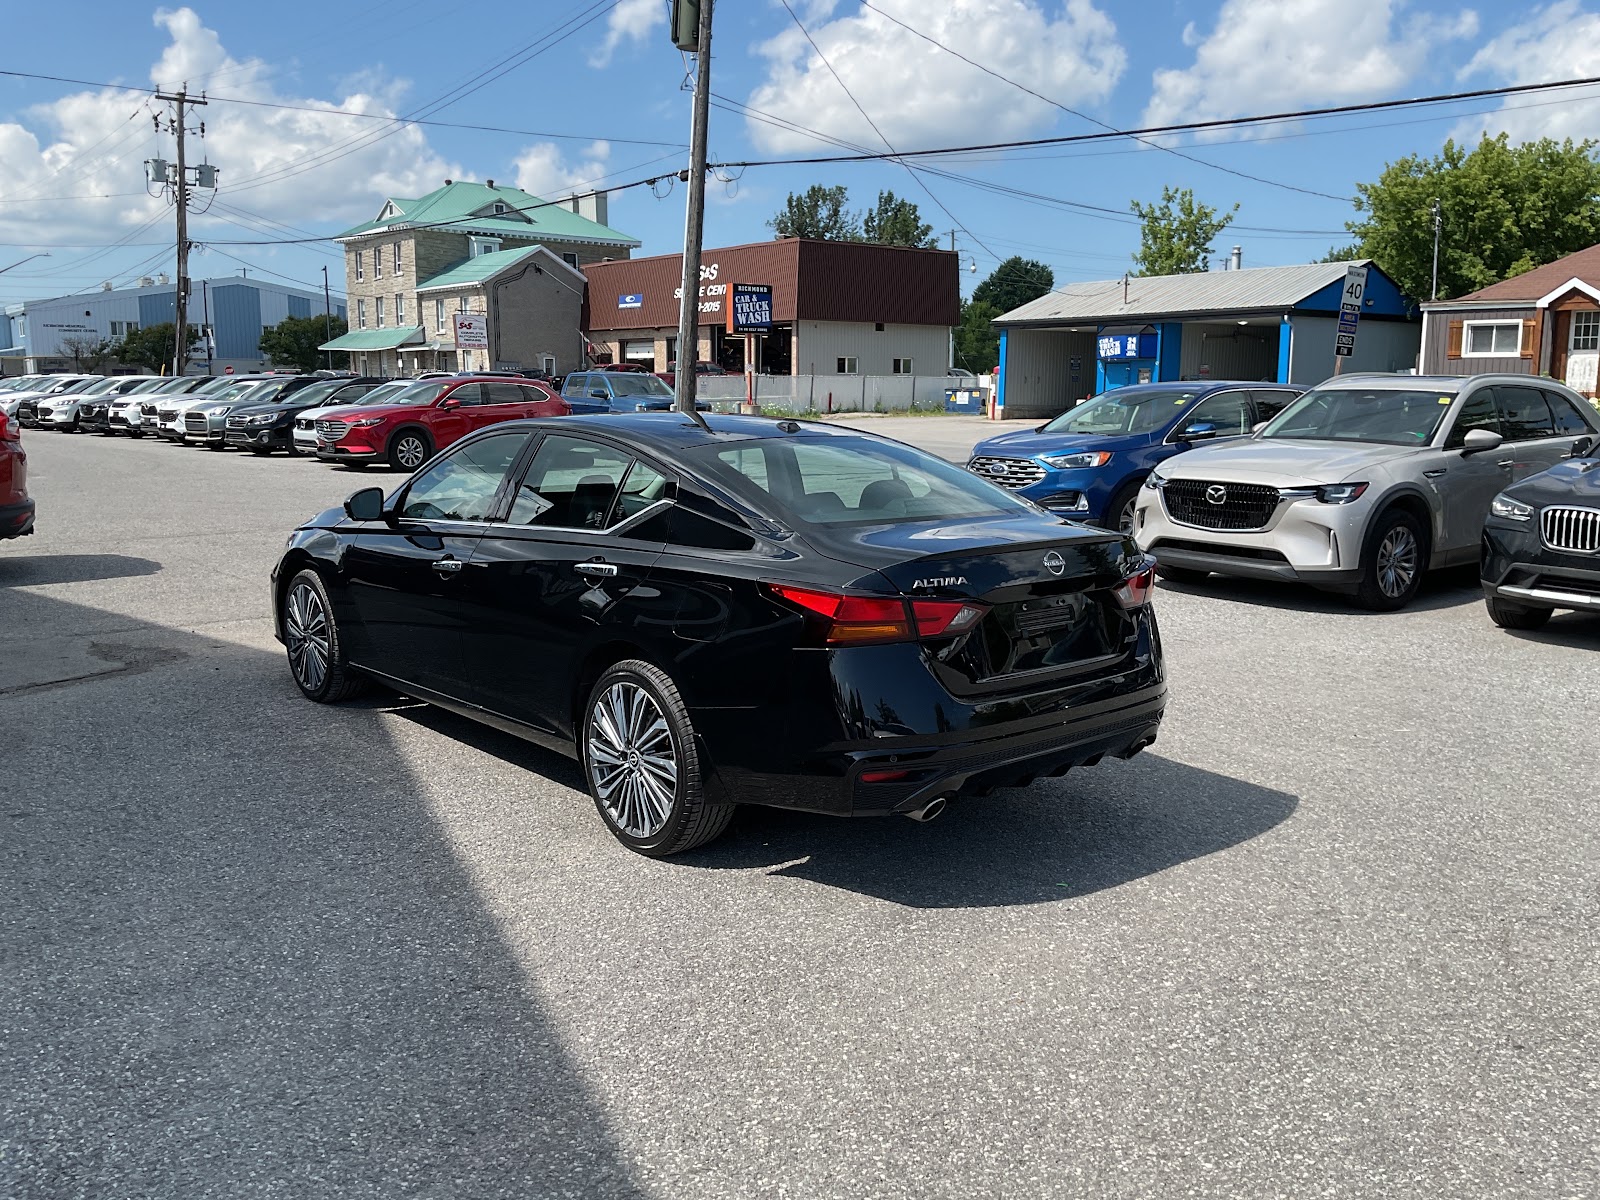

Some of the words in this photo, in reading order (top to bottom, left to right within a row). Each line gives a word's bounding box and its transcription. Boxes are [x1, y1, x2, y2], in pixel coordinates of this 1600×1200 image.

[699, 263, 719, 281] S&S
[1346, 282, 1362, 299] 40
[735, 295, 750, 304] CAR
[751, 294, 758, 302] &
[735, 301, 769, 313] TRUCK
[736, 311, 771, 325] WASH
[1338, 336, 1352, 344] ENDS
[1100, 348, 1120, 357] WASH
[912, 576, 969, 589] ALTIMA
